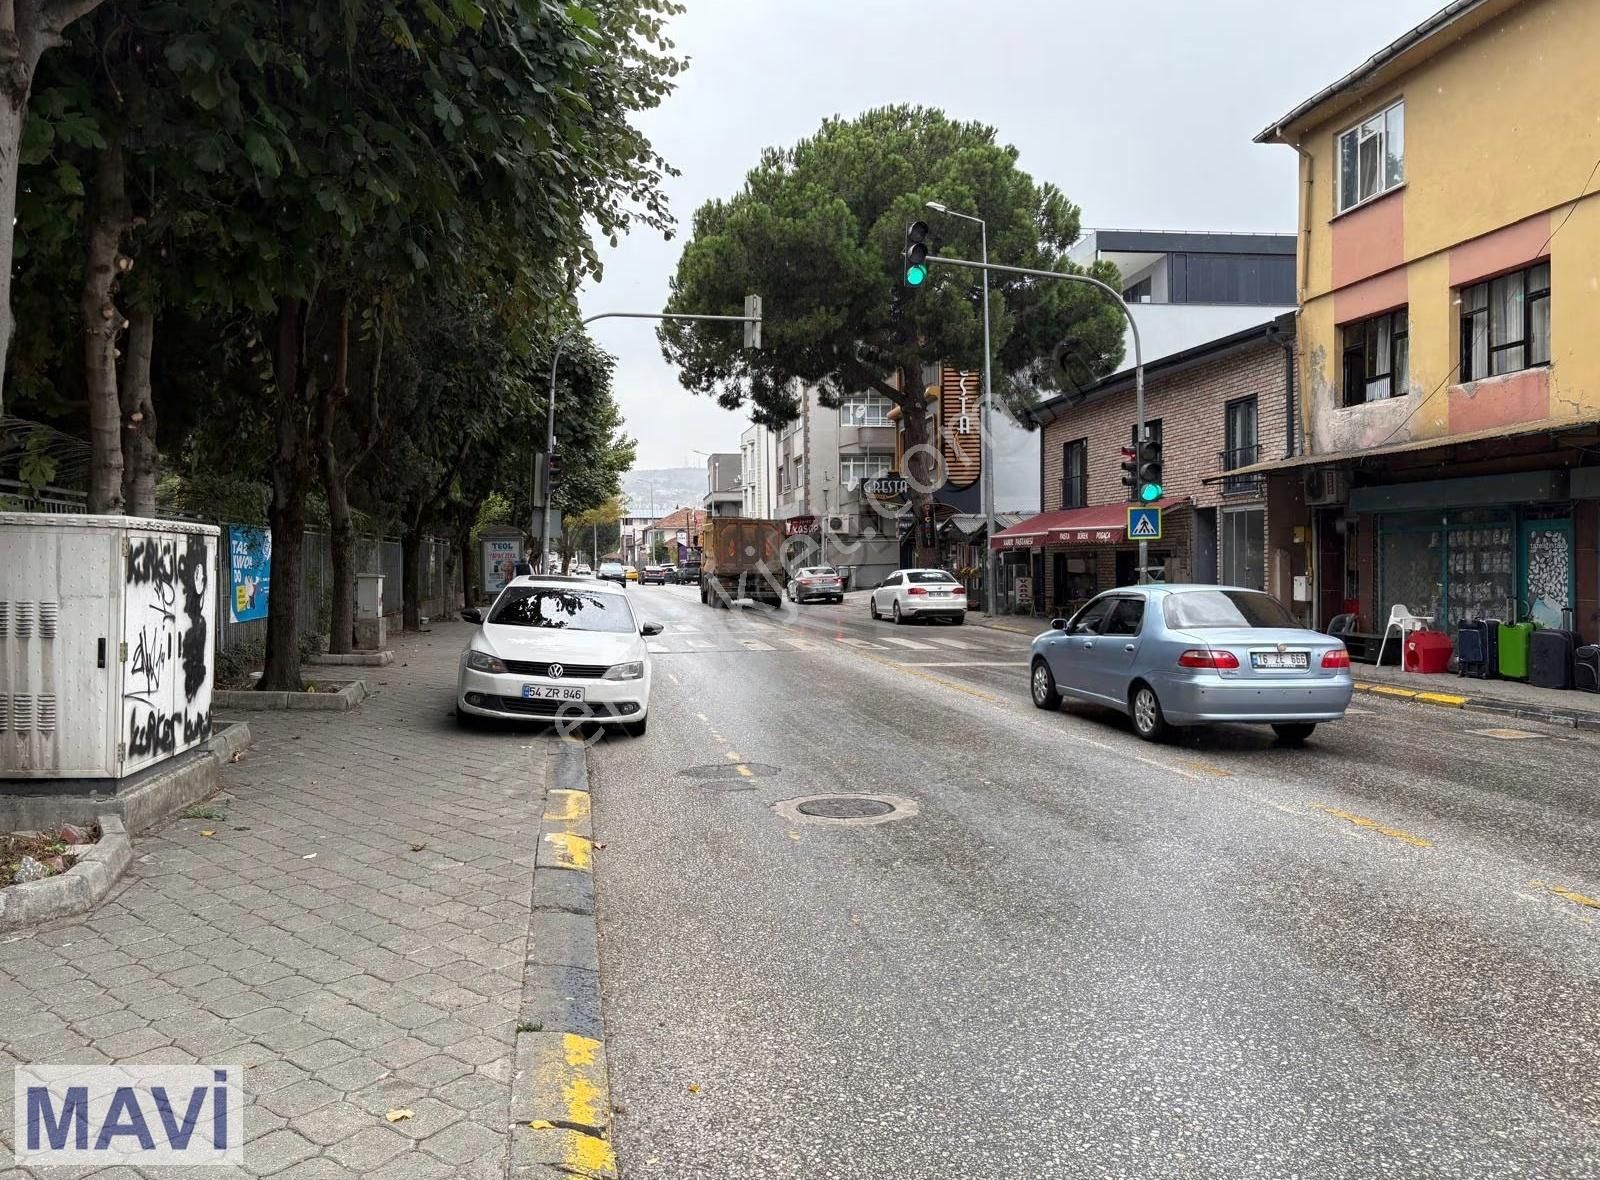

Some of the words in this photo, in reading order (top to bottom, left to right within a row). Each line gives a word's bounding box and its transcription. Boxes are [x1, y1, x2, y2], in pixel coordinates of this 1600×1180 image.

[1258, 654, 1268, 664] 16
[529, 687, 542, 697] 54
[545, 688, 560, 698] ZR
[563, 689, 581, 700] 846
